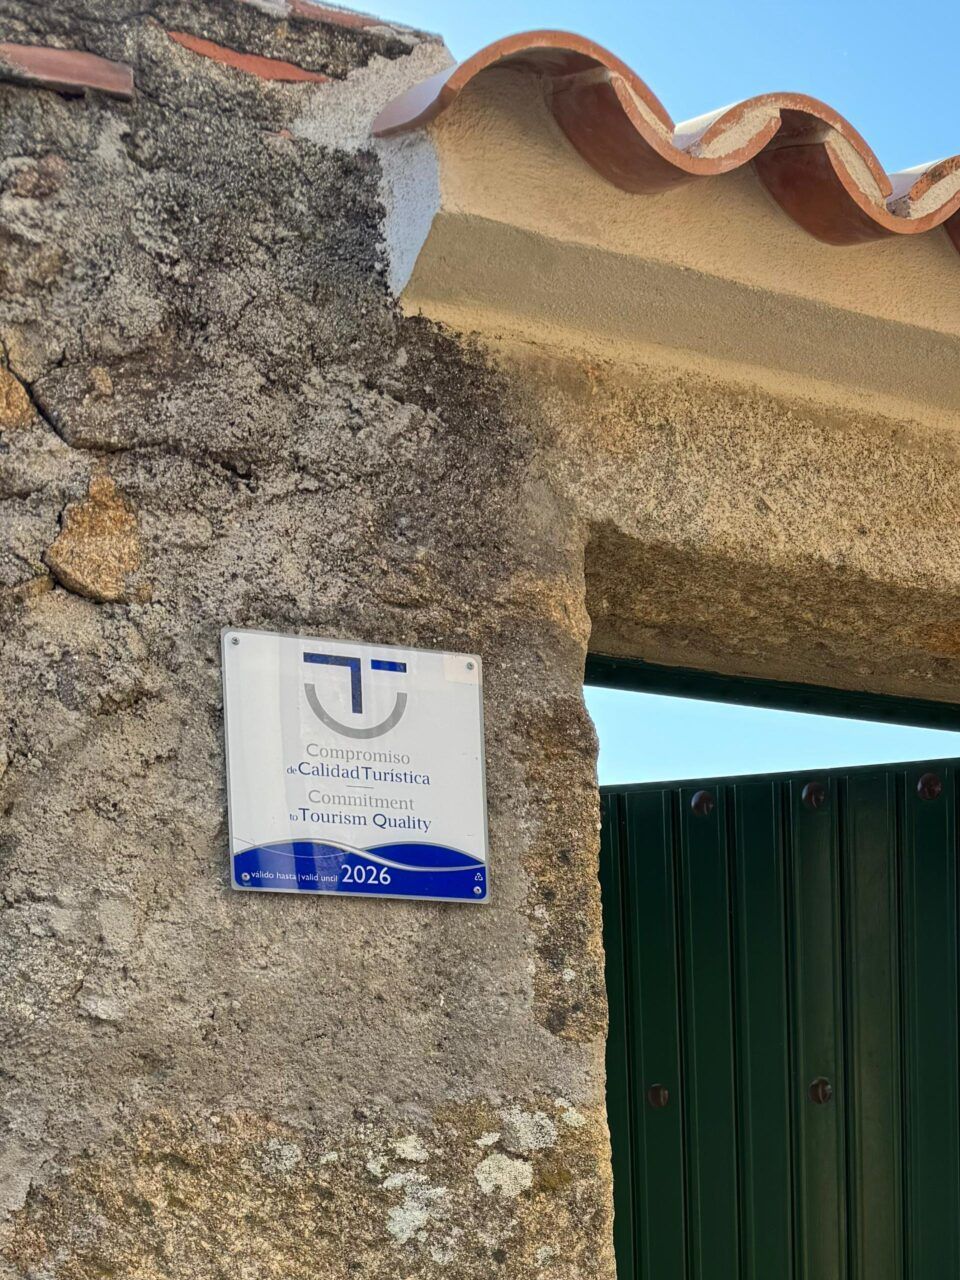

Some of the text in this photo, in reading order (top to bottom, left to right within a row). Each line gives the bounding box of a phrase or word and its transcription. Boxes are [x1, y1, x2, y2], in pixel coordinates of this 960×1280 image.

[306, 742, 411, 766] Compromiso
[286, 761, 431, 786] de Calidad Turística
[308, 789, 416, 811] Commitment
[289, 807, 432, 833] to Tourism Quality
[250, 864, 391, 885] válido hasta valid until 2026
